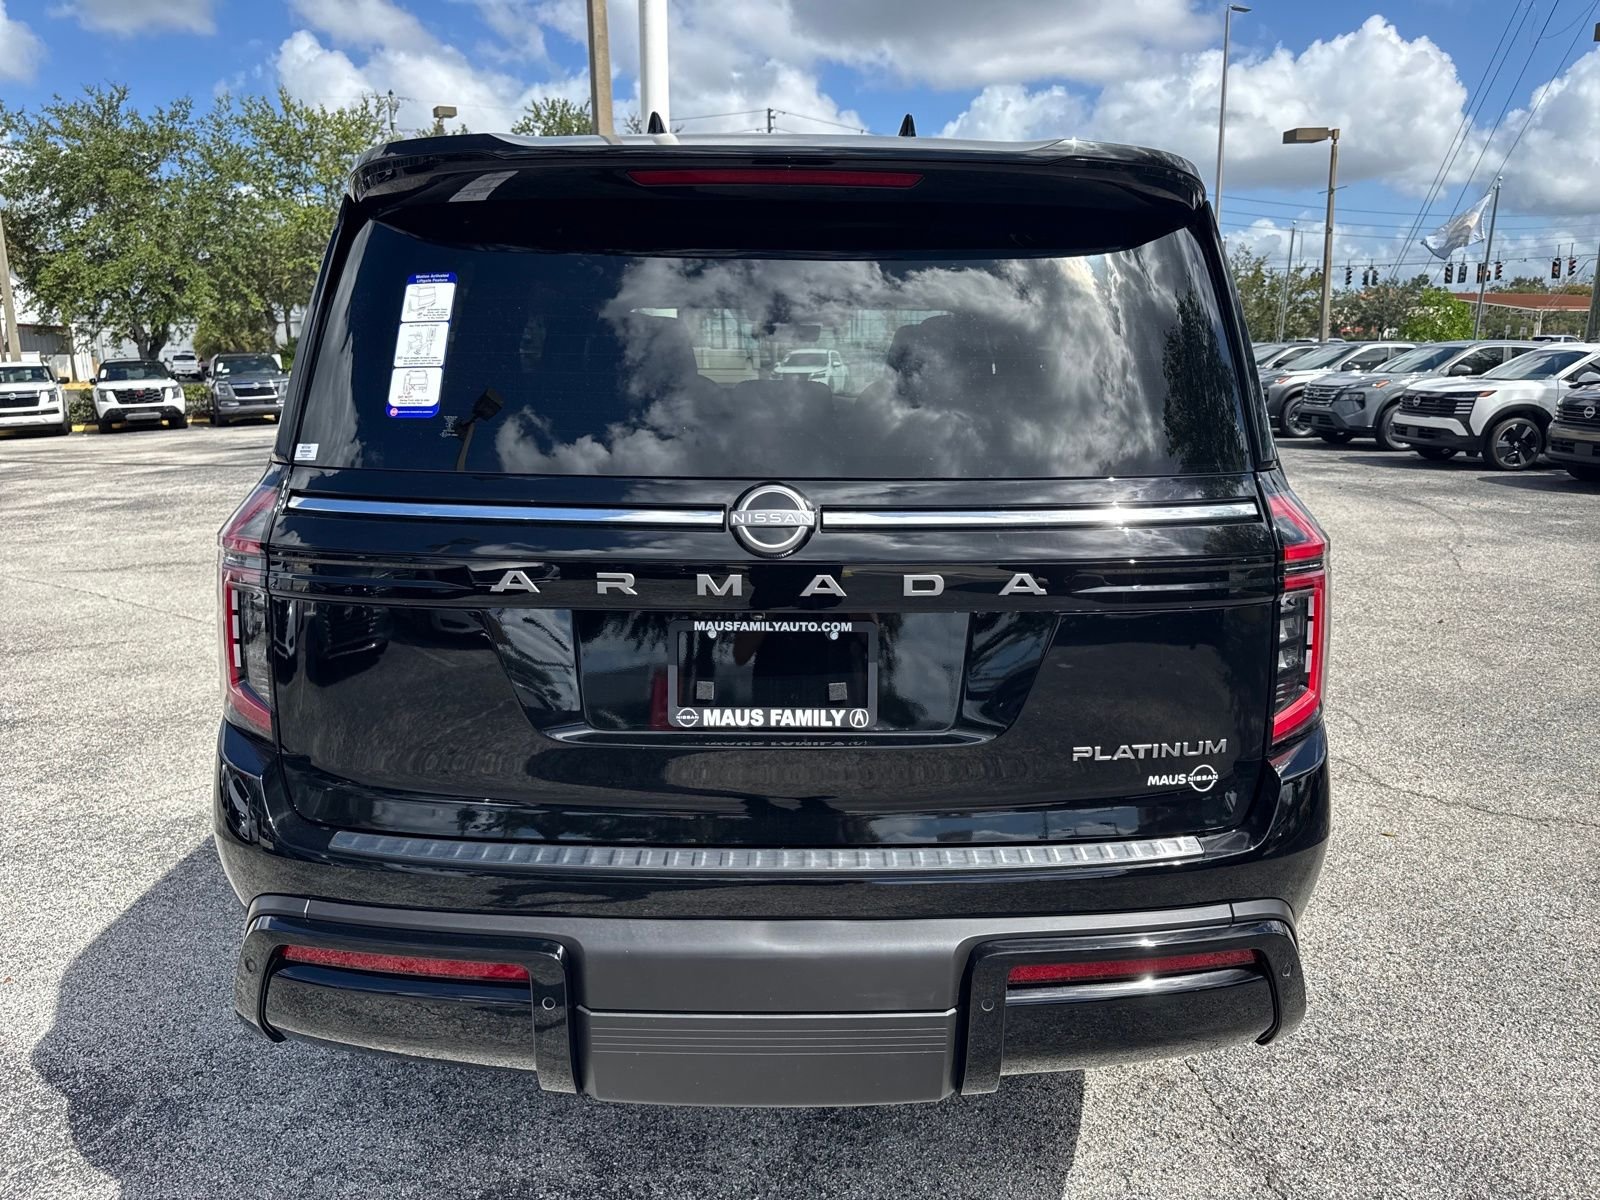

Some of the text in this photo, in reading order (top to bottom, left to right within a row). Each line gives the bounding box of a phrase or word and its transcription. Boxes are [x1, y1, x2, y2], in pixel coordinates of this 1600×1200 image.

[732, 513, 814, 524] NISSAN
[490, 570, 1047, 596] ARMADA
[694, 621, 852, 632] MAUSFAMILYAUTO.COM
[703, 709, 846, 726] MAUS FAMILY
[1072, 738, 1227, 762] PLATINUM
[1147, 773, 1219, 786] MAUS NISSAN
